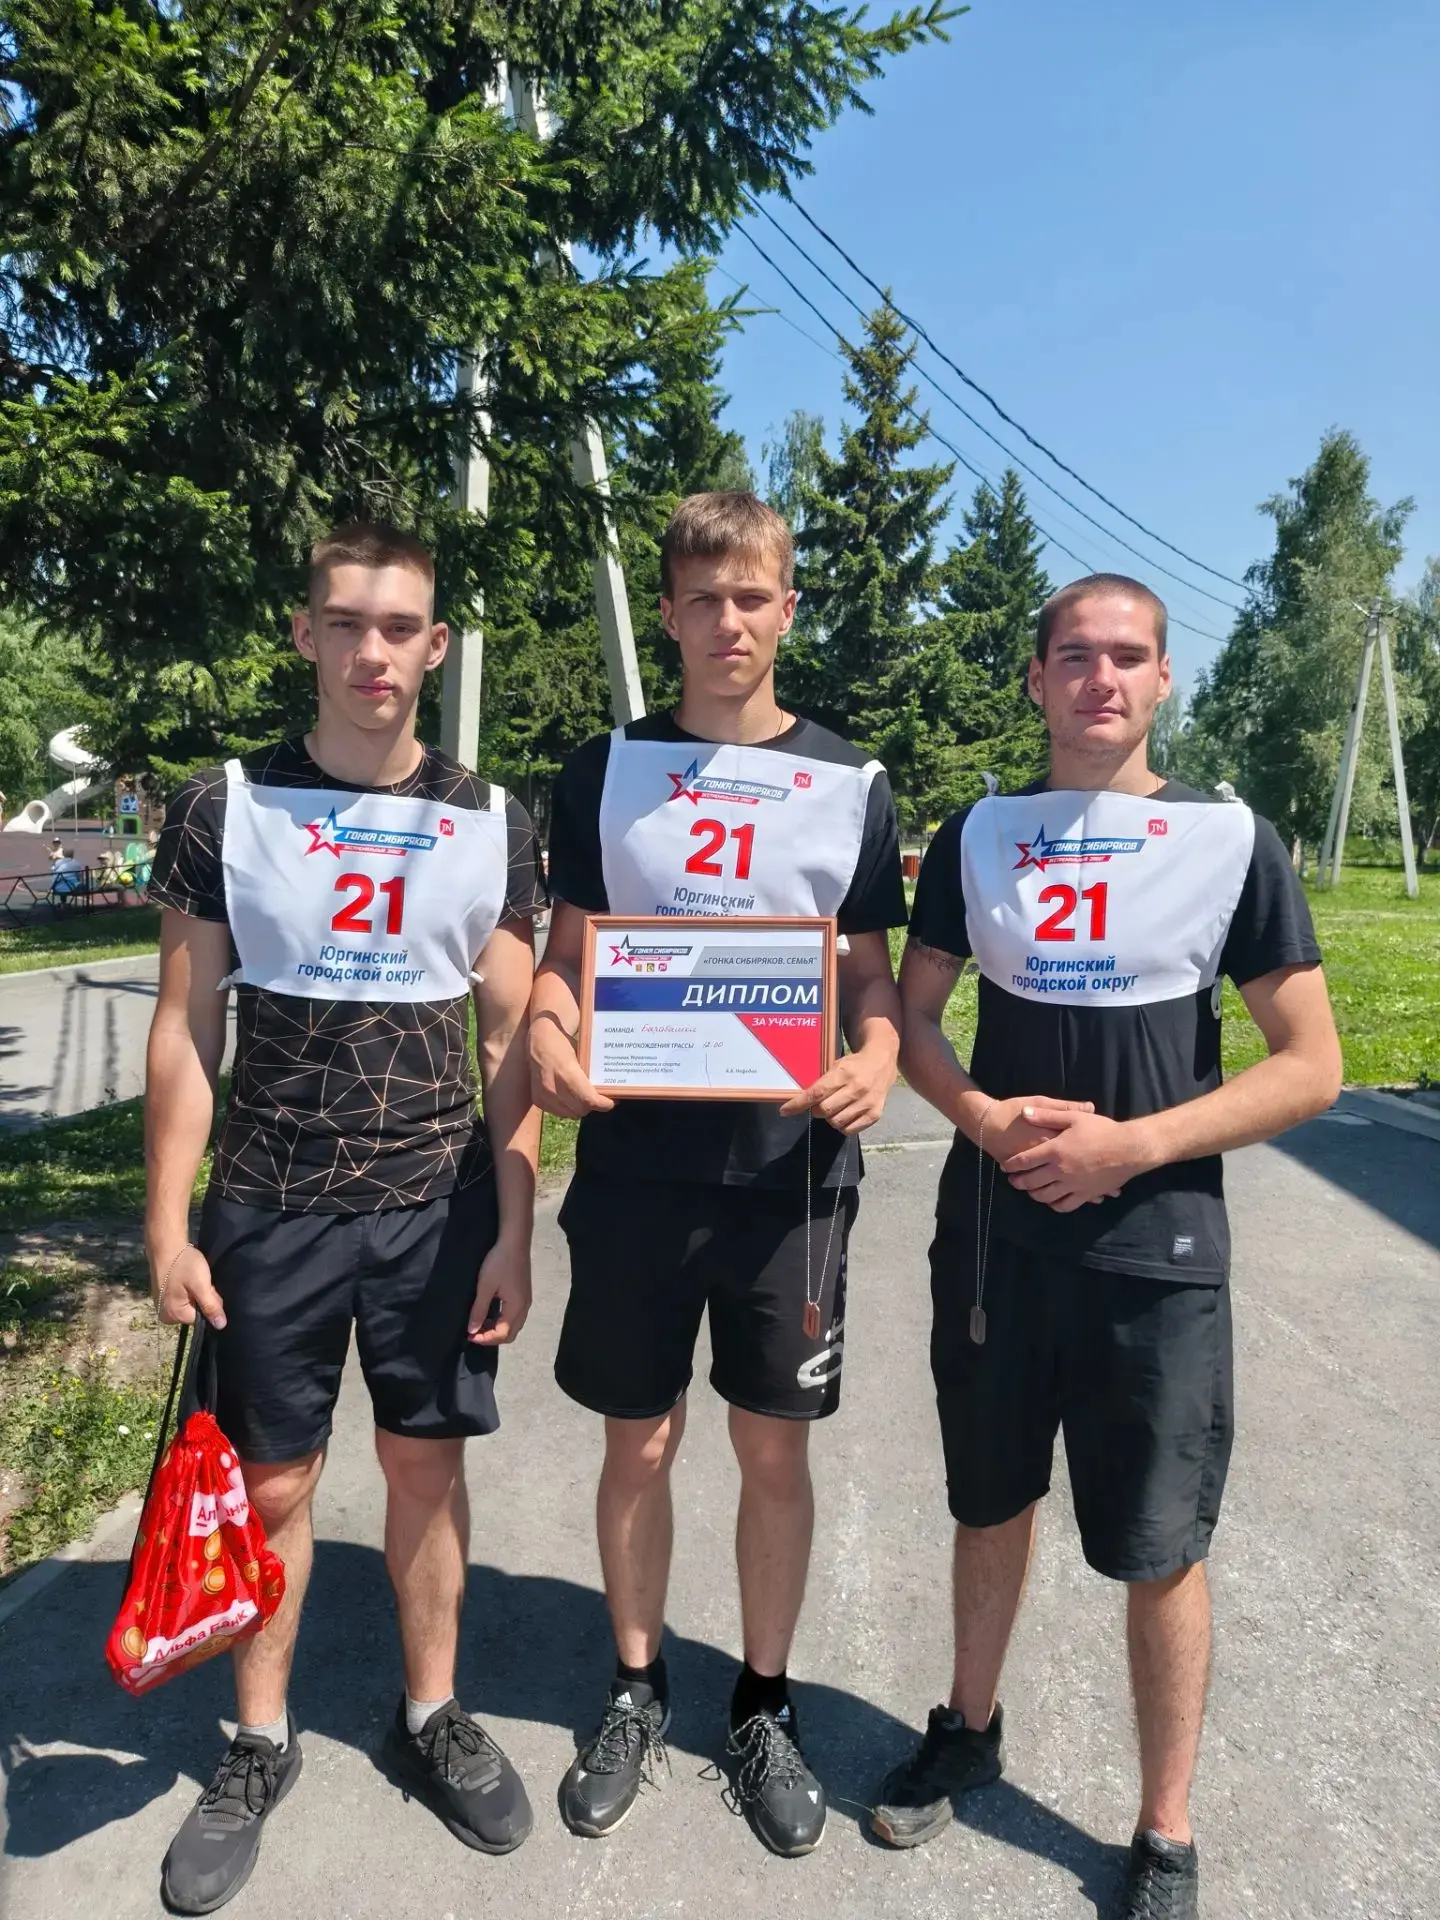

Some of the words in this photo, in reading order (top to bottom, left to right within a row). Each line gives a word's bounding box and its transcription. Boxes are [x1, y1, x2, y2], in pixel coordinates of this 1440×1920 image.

[703, 780, 732, 790] ГОНКА
[732, 783, 783, 798] СИБИРЯКОВ
[344, 830, 376, 841] ГОНКА
[377, 834, 432, 848] СИБИРЯКОВ
[685, 818, 755, 880] 21
[1050, 843, 1081, 853] ГОНКА
[1080, 841, 1137, 851] СИБИРЯКОВ
[332, 873, 405, 935] 21
[674, 887, 755, 910] Юргинский
[1035, 882, 1107, 941] 21
[319, 945, 408, 964] Юргинский
[703, 956, 734, 965] «ГОНКА
[297, 963, 382, 982] городской
[385, 969, 425, 985] округ
[1025, 955, 1115, 975] Юргинский
[1012, 974, 1087, 993] городской
[1091, 974, 1139, 992] округ
[681, 984, 818, 1007] ДИПЛОМ
[751, 1017, 768, 1027] ЗА
[768, 1017, 817, 1027] УЧАСТИЕ
[153, 1630, 206, 1664] Альфа
[210, 1609, 248, 1634] Банк
